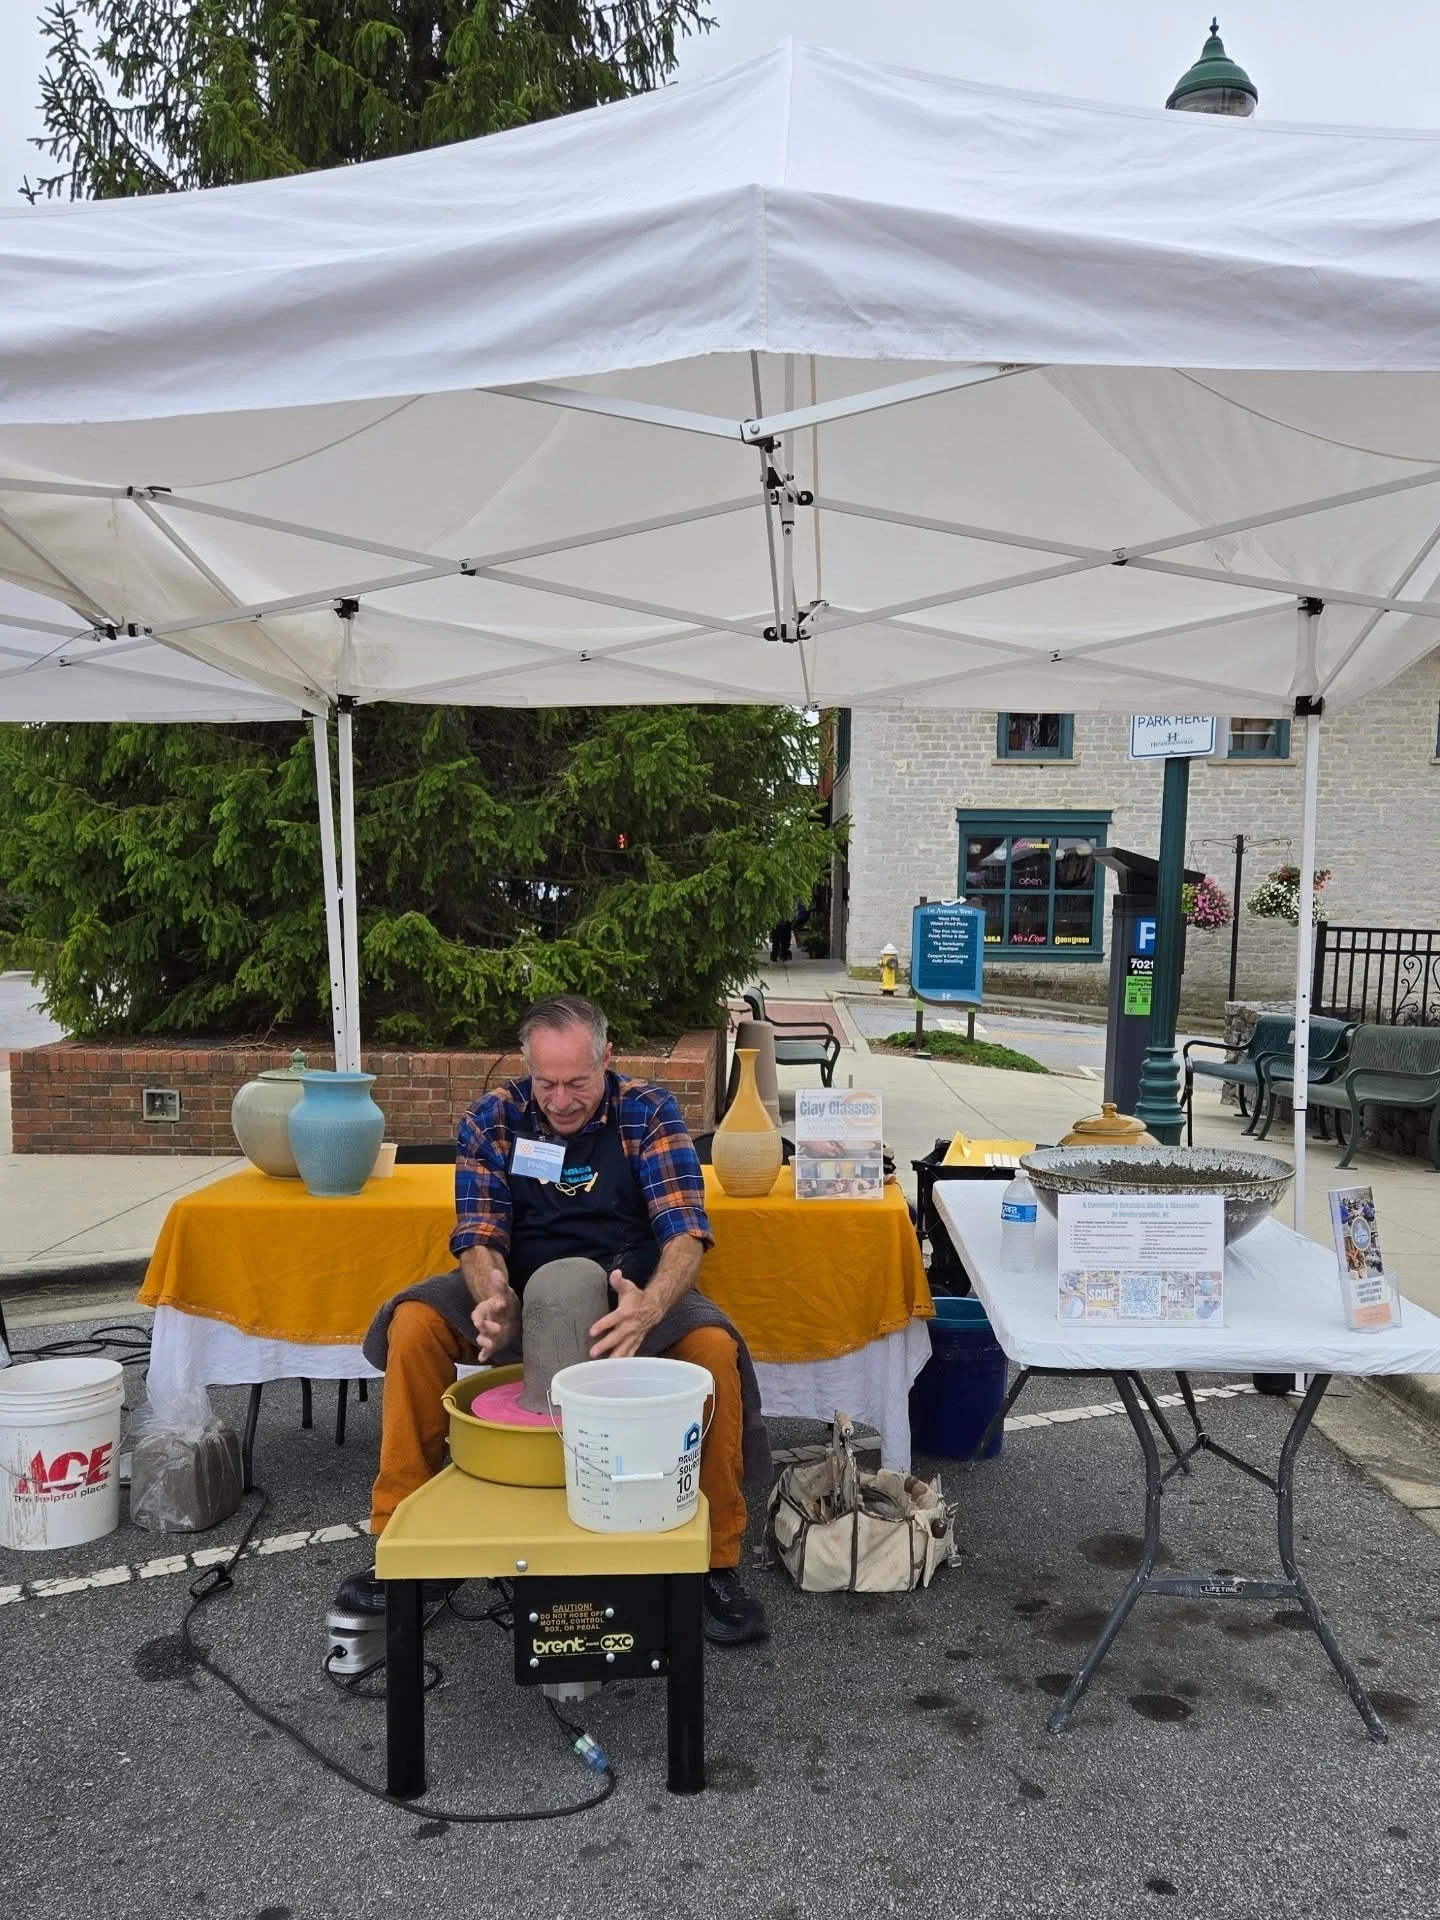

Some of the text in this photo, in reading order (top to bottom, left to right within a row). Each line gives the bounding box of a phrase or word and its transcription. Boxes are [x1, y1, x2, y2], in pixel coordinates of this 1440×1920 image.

[1138, 716, 1171, 728] PARK
[1139, 922, 1156, 949] P
[1131, 960, 1154, 969] 7021
[800, 1101, 876, 1117] Clay Classes
[1088, 1288, 1114, 1301] SCAN
[1168, 1288, 1184, 1302] ME
[14, 1441, 113, 1494] ACE
[677, 1473, 692, 1494] 10
[35, 1491, 76, 1503] helpful
[80, 1483, 109, 1497] place.
[552, 1603, 593, 1612] CAUTION!
[533, 1636, 585, 1654] brent
[602, 1636, 632, 1648] CXC
